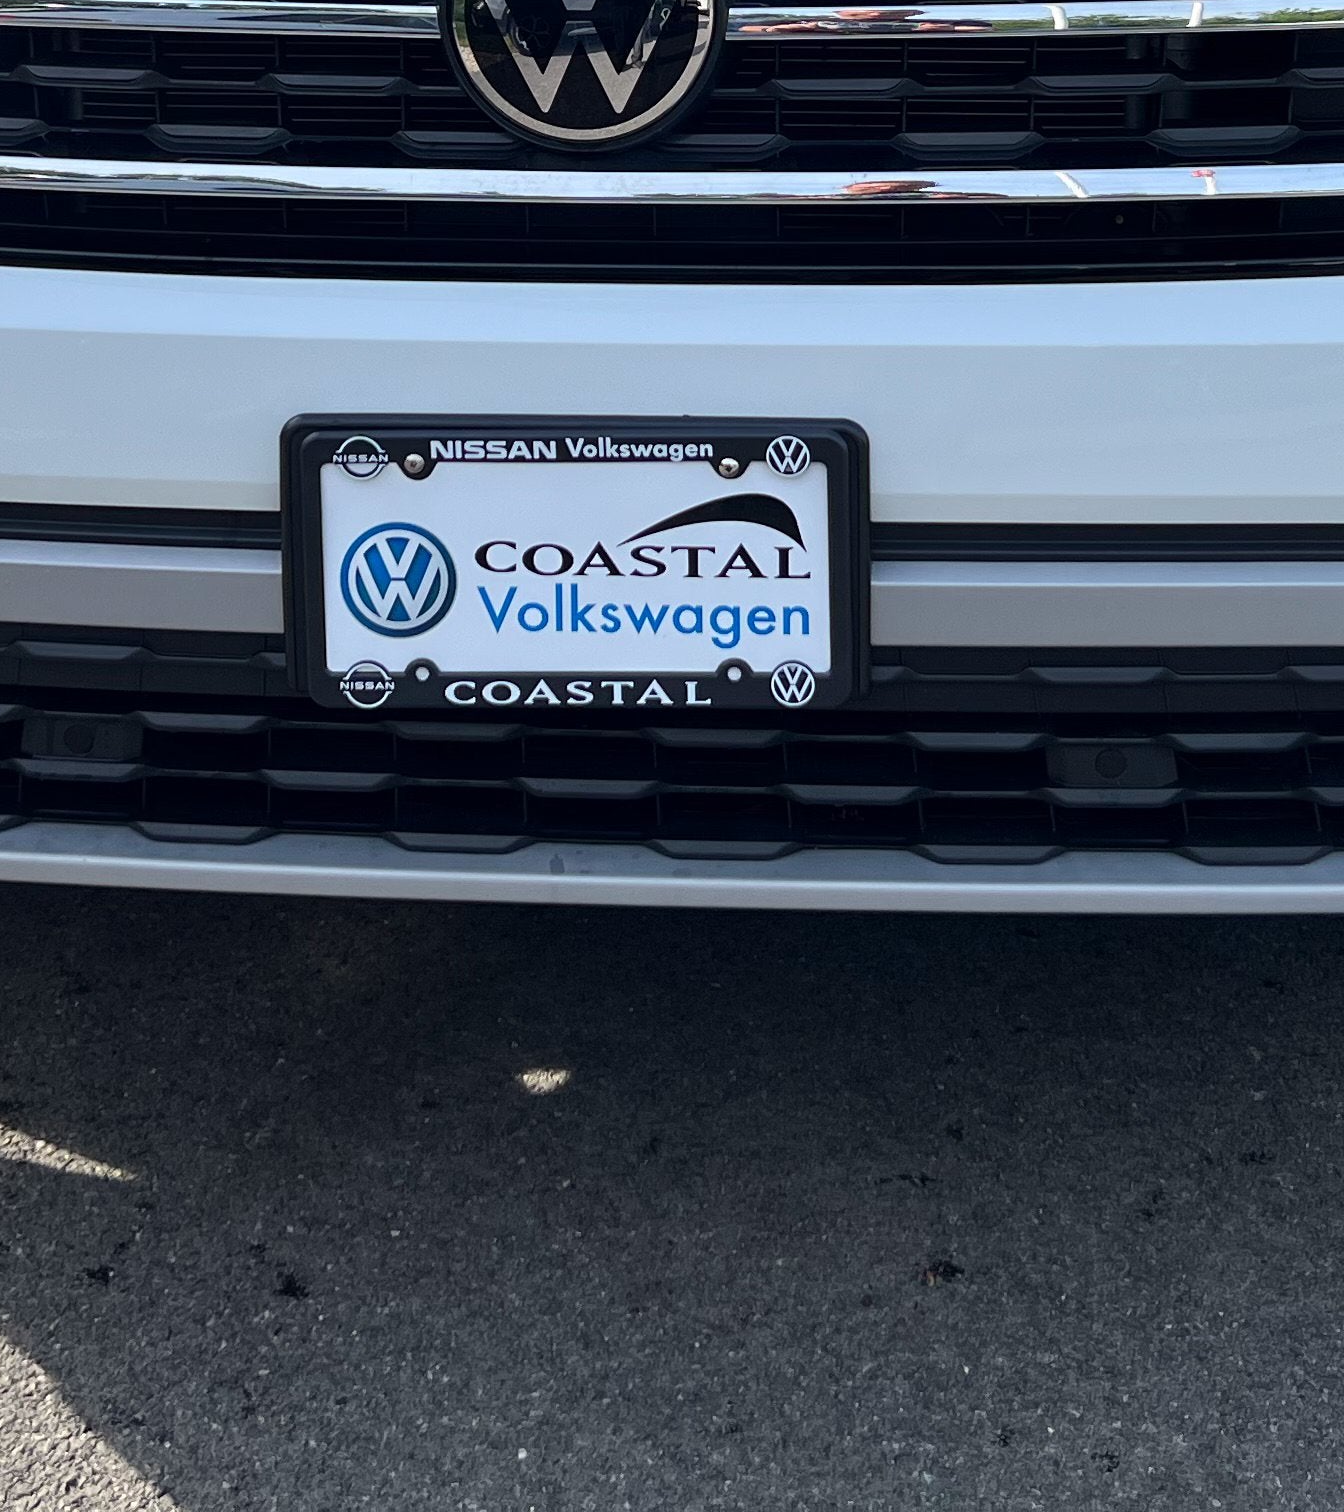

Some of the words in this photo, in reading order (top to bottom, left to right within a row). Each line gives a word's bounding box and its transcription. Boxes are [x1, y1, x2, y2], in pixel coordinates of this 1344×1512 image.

[332, 452, 389, 464] NISSAN
[429, 440, 557, 460] NISSAN
[564, 436, 713, 463] Volkswagen
[474, 540, 811, 580] COASTAL
[476, 583, 810, 649] Volkswagen
[339, 681, 395, 691] NISSAN
[444, 678, 712, 706] COASTAL
